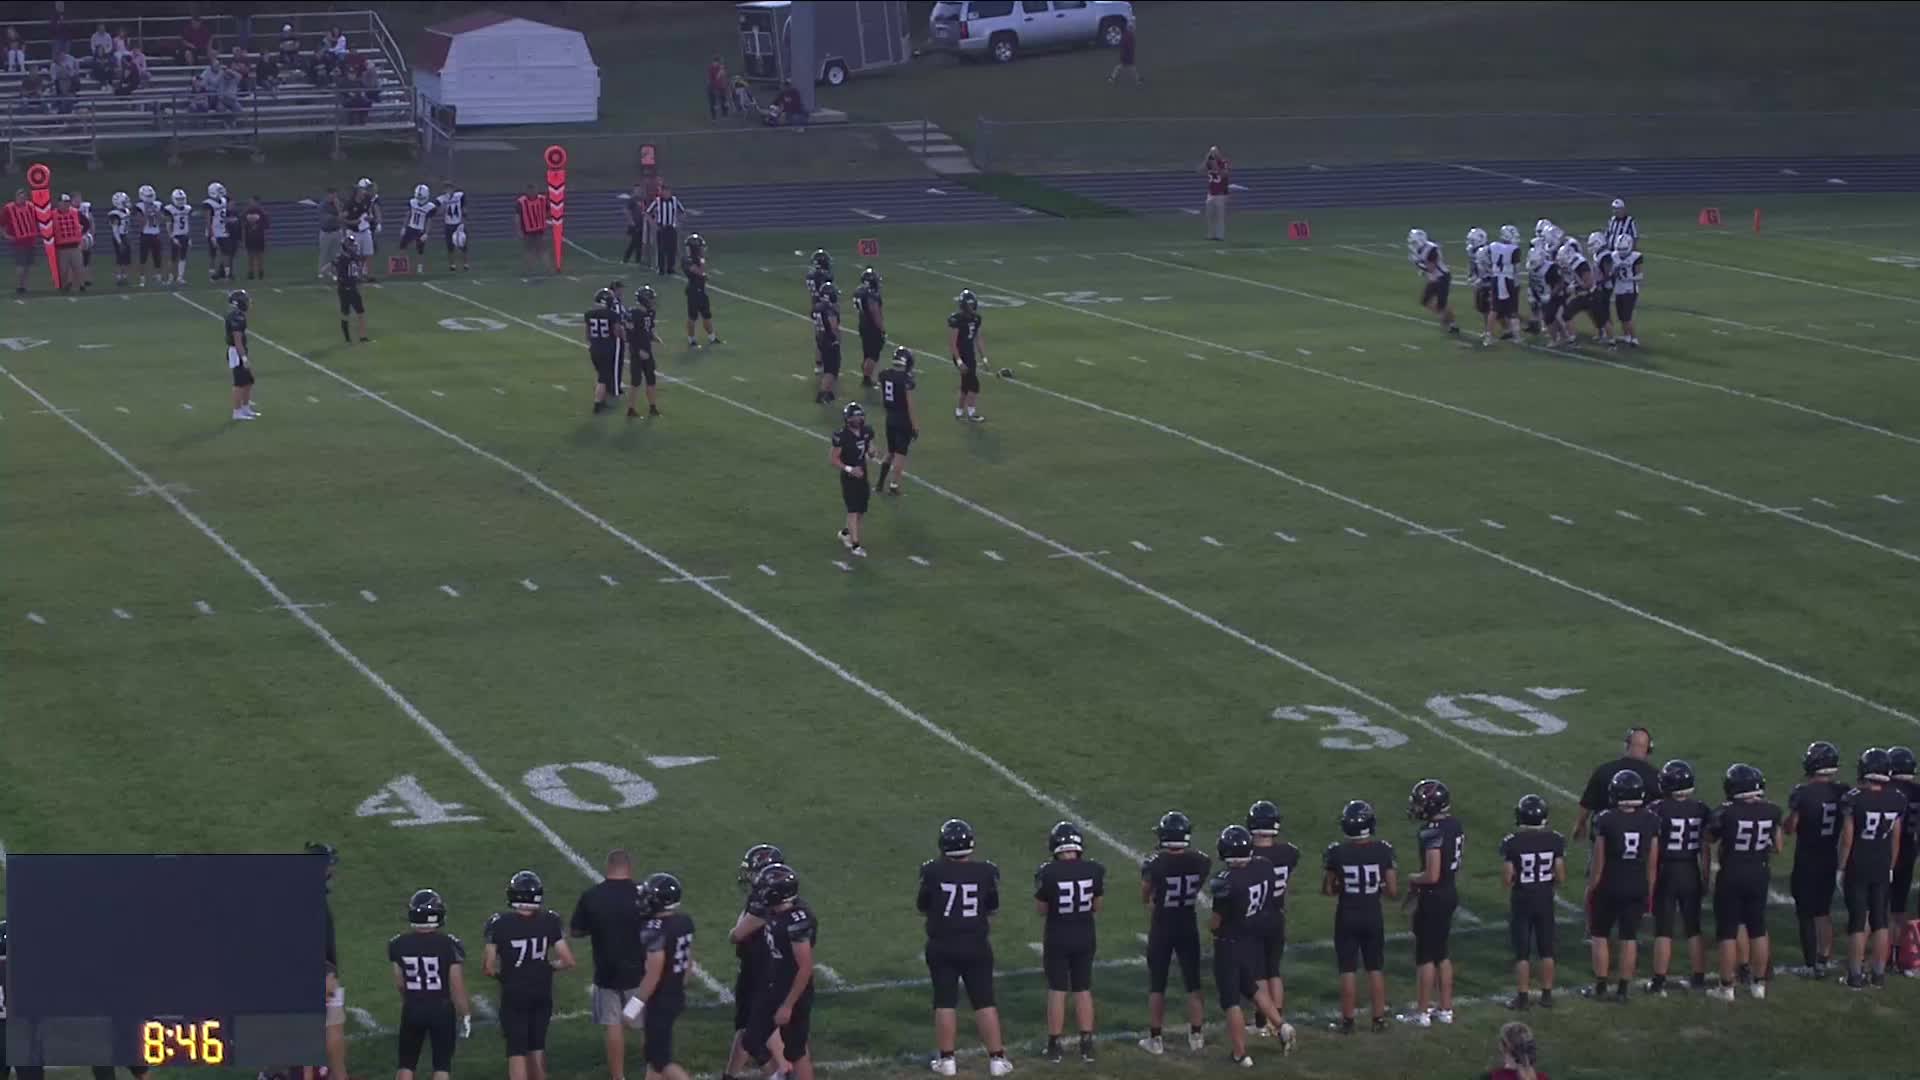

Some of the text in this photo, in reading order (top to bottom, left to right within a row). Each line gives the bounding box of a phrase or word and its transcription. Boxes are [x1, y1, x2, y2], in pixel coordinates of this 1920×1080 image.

[1820, 802, 1838, 836] 5
[1861, 811, 1899, 840] 87
[1622, 831, 1641, 860] 8
[1342, 863, 1382, 894] 20
[1519, 850, 1556, 884] 82
[940, 883, 979, 918] 75
[1056, 879, 1095, 914] 35
[1245, 880, 1269, 917] 81
[511, 936, 549, 968] 74
[401, 956, 443, 991] 38
